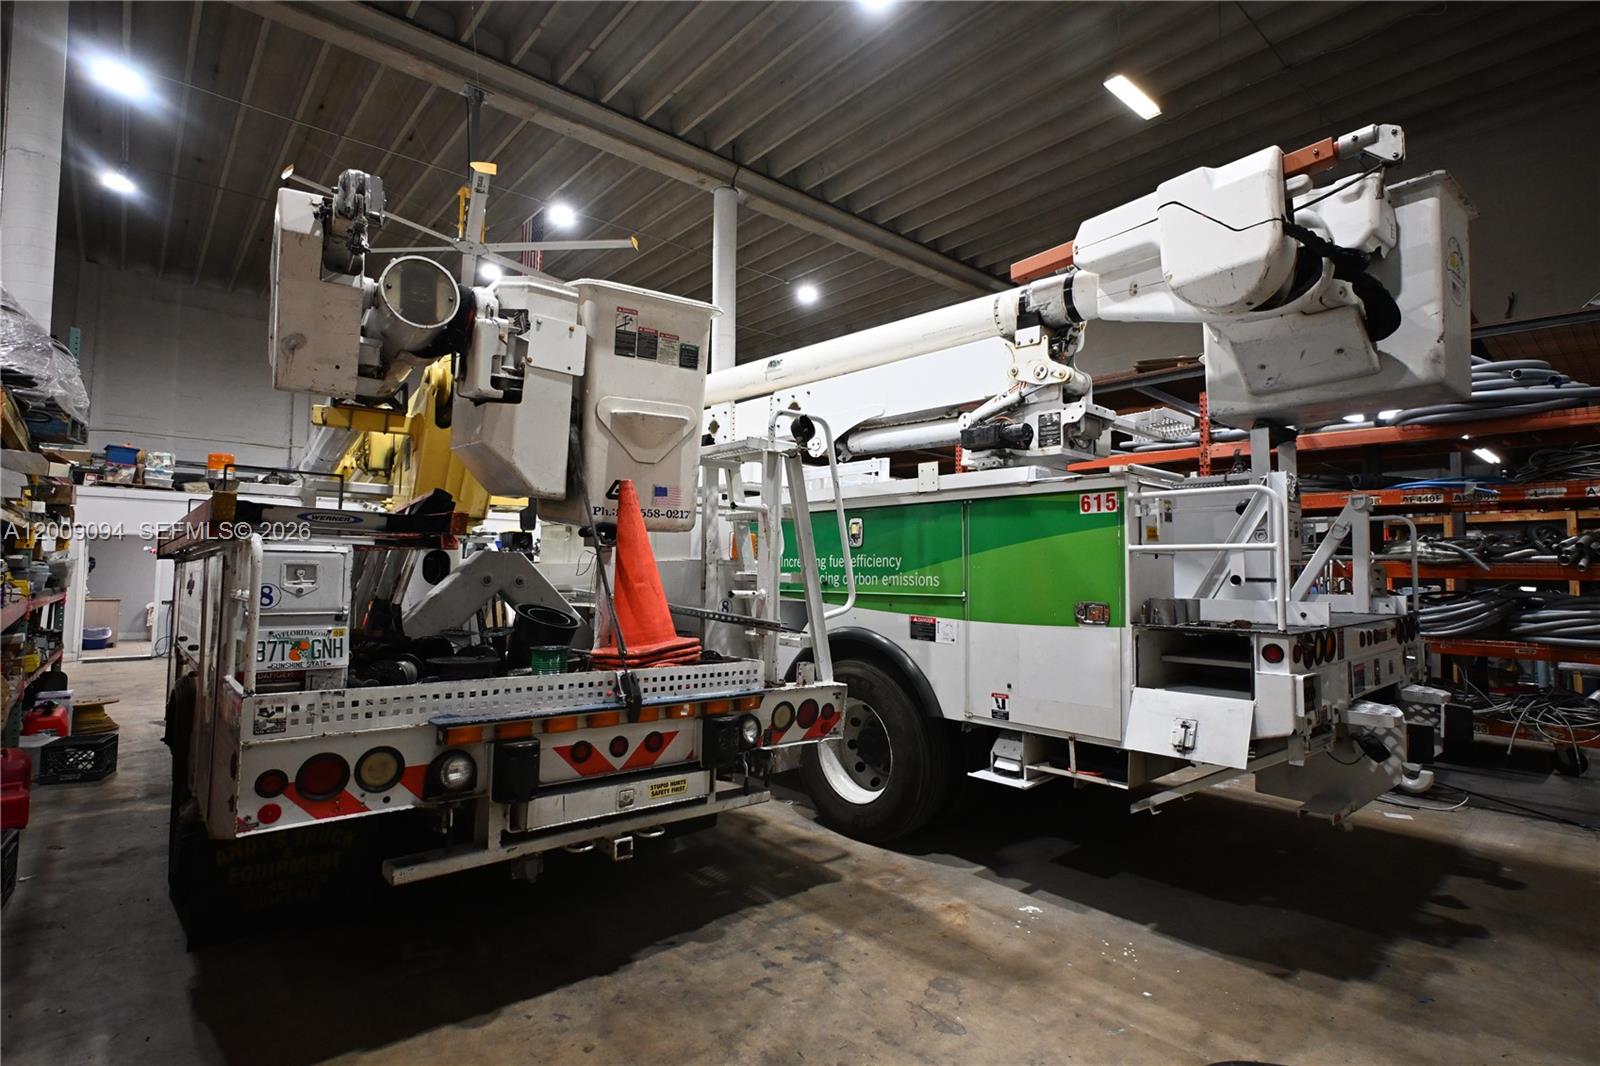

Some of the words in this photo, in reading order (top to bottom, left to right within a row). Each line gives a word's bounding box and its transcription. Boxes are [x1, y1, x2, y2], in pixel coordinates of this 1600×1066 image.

[1081, 492, 1116, 513] 615
[311, 514, 351, 522] WERNER
[851, 554, 902, 570] efficiency
[842, 573, 879, 586] crbon
[881, 572, 940, 587] emissions
[311, 638, 343, 659] GNH
[650, 782, 669, 790] STUPID
[669, 779, 686, 787] HURTS
[651, 788, 670, 797] SAFETY
[671, 785, 685, 793] FIRST
